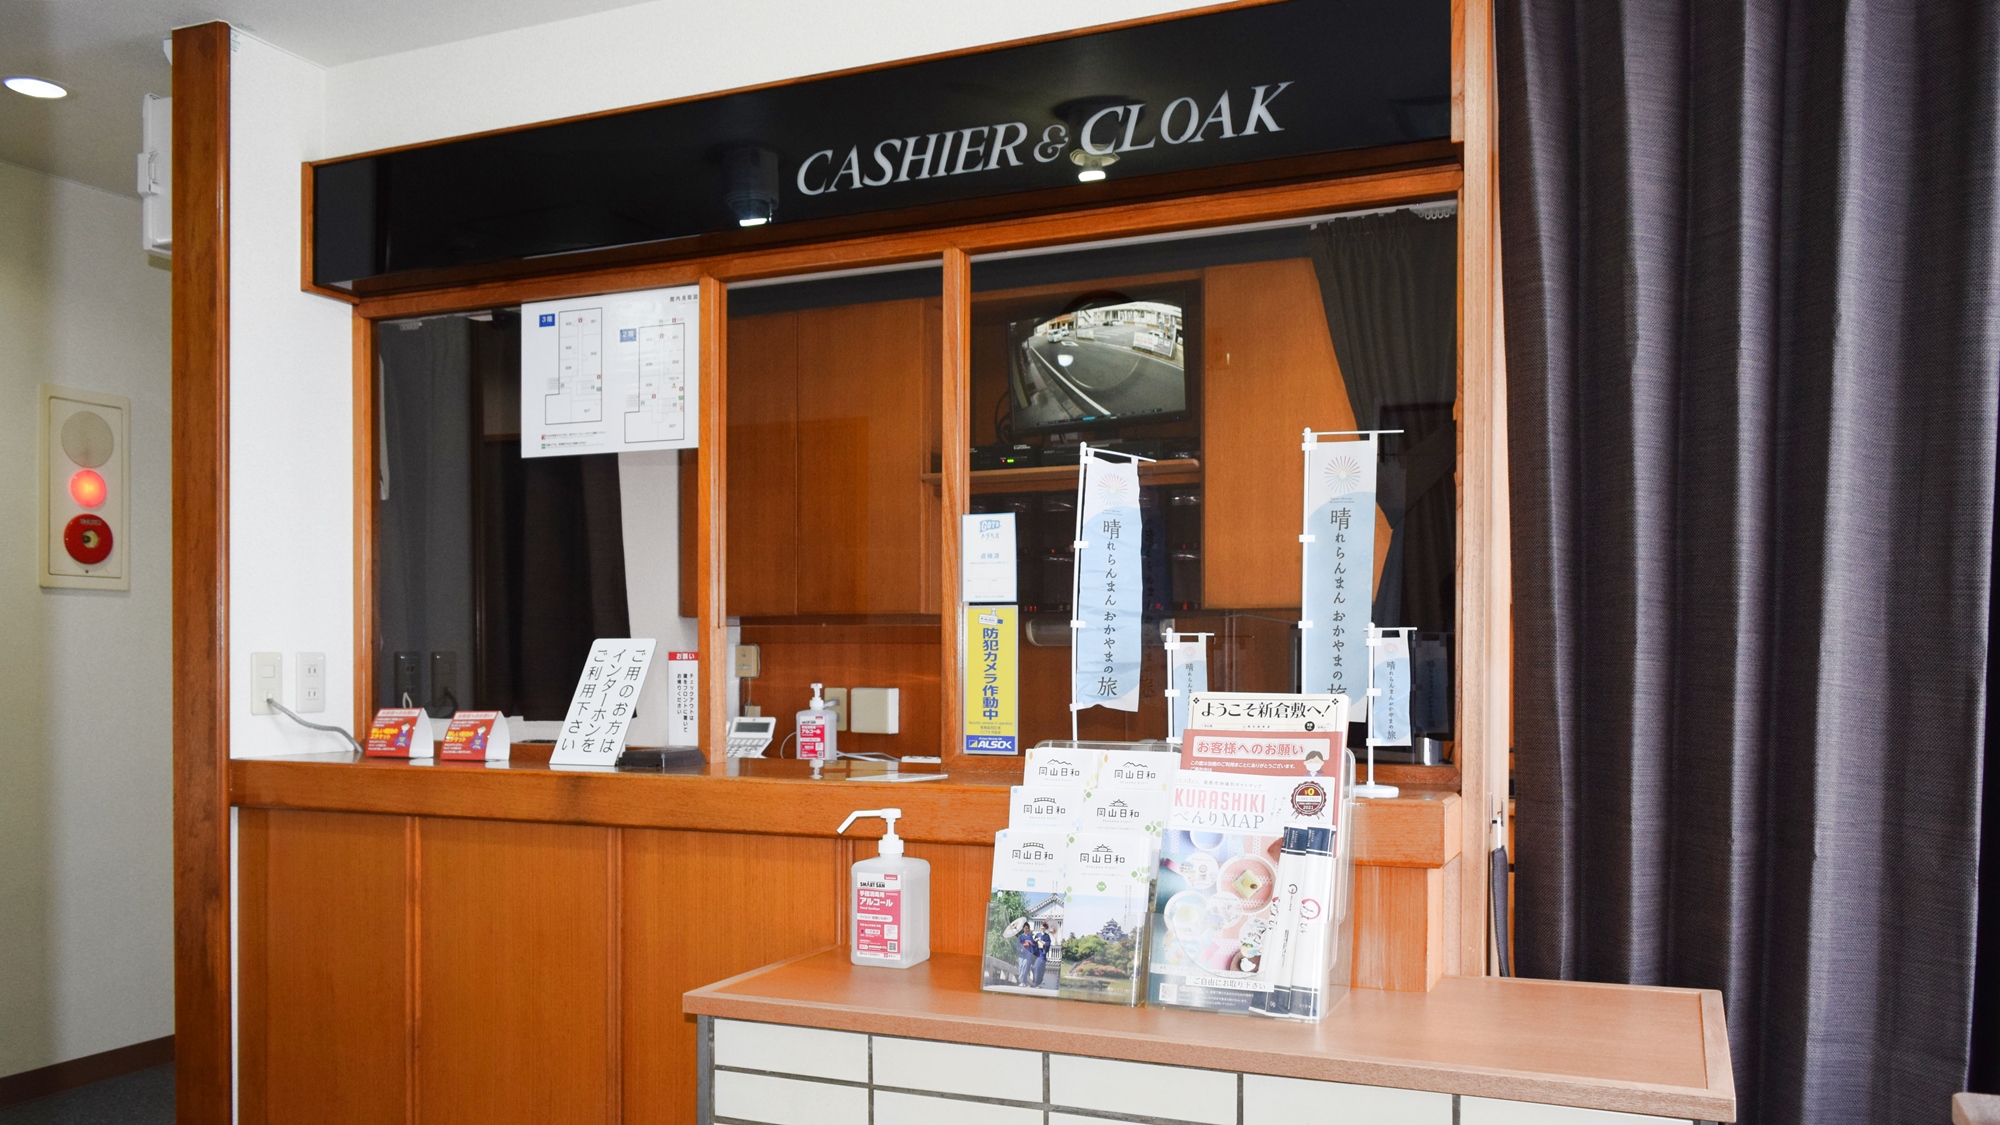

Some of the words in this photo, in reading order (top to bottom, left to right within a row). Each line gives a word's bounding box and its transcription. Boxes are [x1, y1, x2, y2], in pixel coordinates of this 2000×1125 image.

[797, 121, 1029, 196] CASHIER
[1034, 124, 1070, 163] &
[1080, 81, 1296, 156] CLOAK
[1097, 519, 1122, 696] 晴れらんまんおかやまの旅
[982, 627, 999, 721] 防犯カメラ作動中
[561, 649, 608, 751] ご利用下さい
[581, 649, 627, 753] インターホンを
[600, 649, 646, 753] ご用のお方は
[978, 740, 1012, 749] ALSOK
[1197, 741, 1304, 756] お客様へのお願い
[1038, 767, 1080, 777] 岡山日和
[1114, 769, 1156, 779] 岡山日和
[1174, 788, 1266, 814] KURASHIKI
[1023, 805, 1066, 815] 岡山日和
[1096, 807, 1140, 818] 岡山日和
[1011, 850, 1054, 860] 岡山日和
[1079, 853, 1125, 864] 岡山日和
[859, 898, 893, 907] アルコール
[1193, 977, 1267, 990] ご自由にお取り下さい
